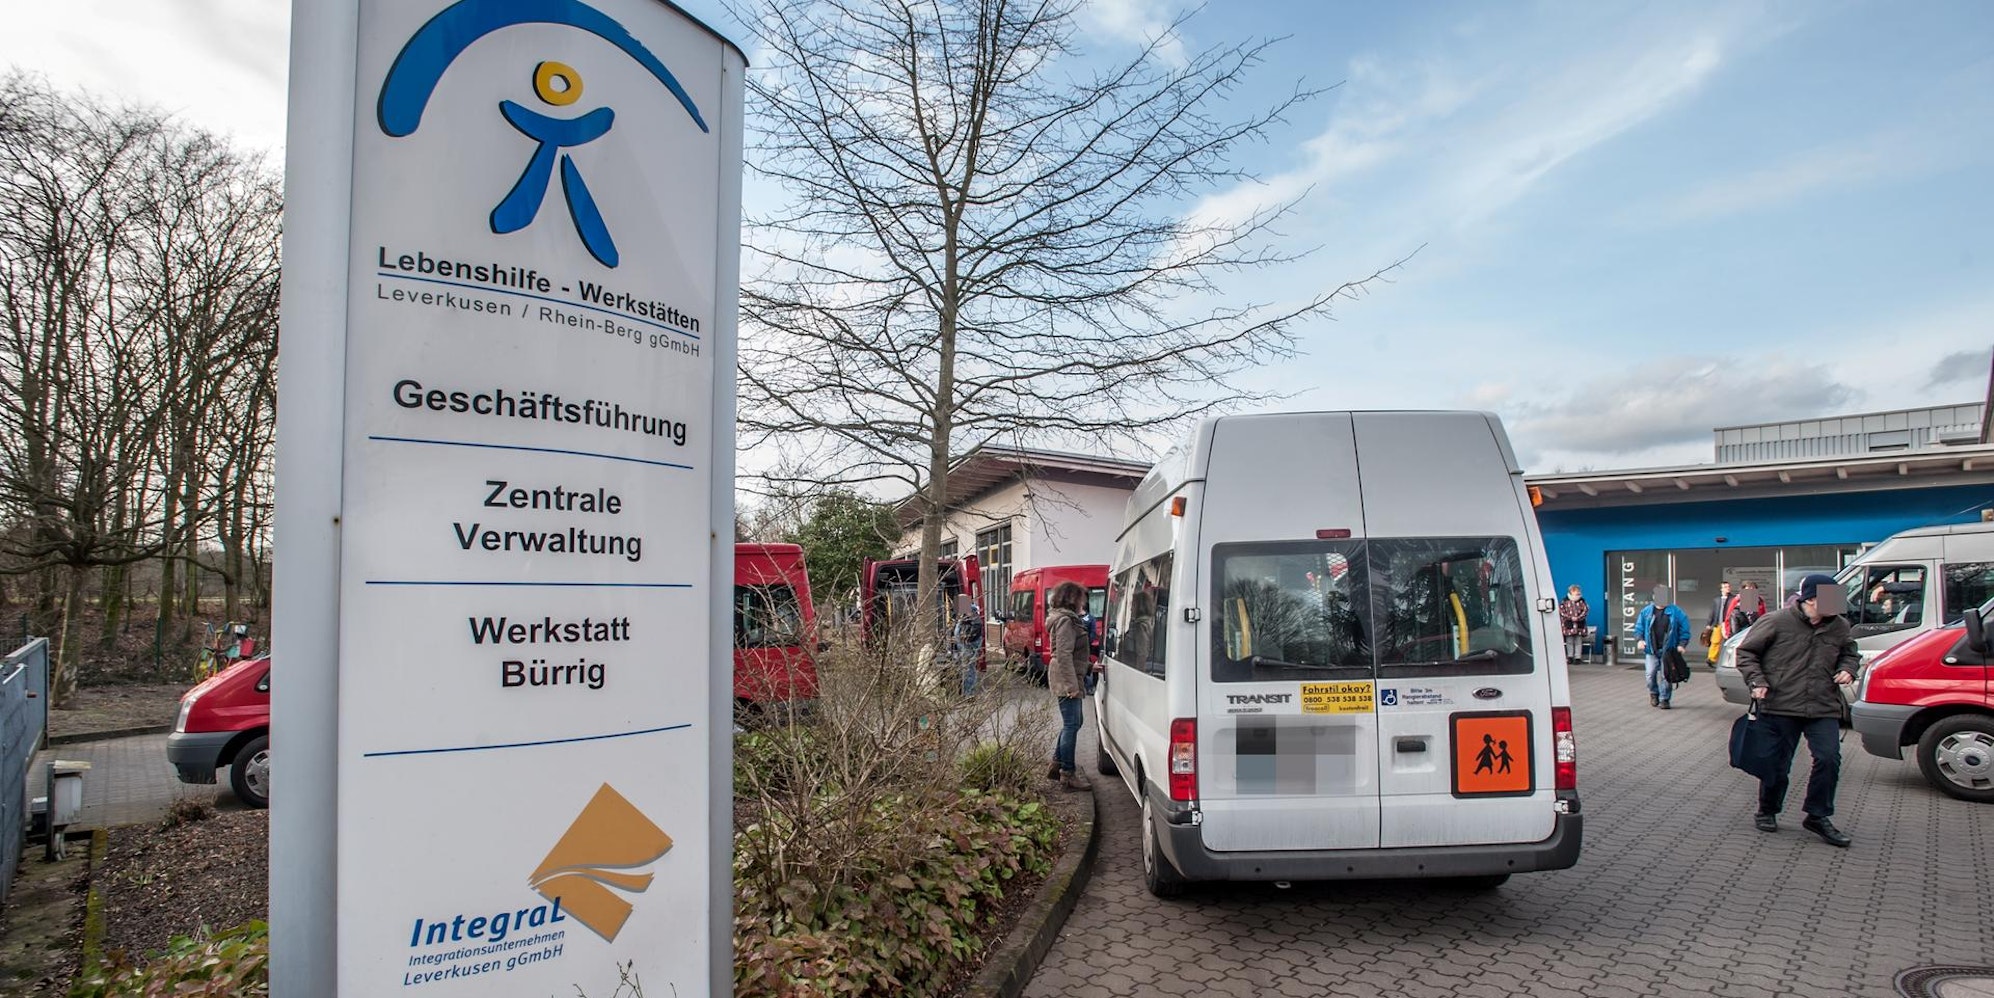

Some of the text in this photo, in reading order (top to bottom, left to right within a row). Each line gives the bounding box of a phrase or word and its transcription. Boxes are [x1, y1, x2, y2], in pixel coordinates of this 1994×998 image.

[378, 246, 551, 294] Lebenshilfe
[579, 280, 700, 332] Werkstätten
[377, 284, 701, 358] Leverkusen / Rhein-Berg gGmbH
[393, 379, 687, 447] Geschäftsführung
[484, 480, 622, 515] Zentrale
[453, 523, 642, 562] Verwaltung
[1623, 561, 1636, 655] EINGANG
[469, 616, 631, 645] Werkstatt
[502, 658, 606, 690] Bürrig
[1303, 684, 1371, 694] Fahrstil okay?
[1226, 693, 1292, 705] TRANSIT
[403, 944, 564, 986] Leverkusen gGmbH
[408, 930, 565, 967] Integrationsunternehmen
